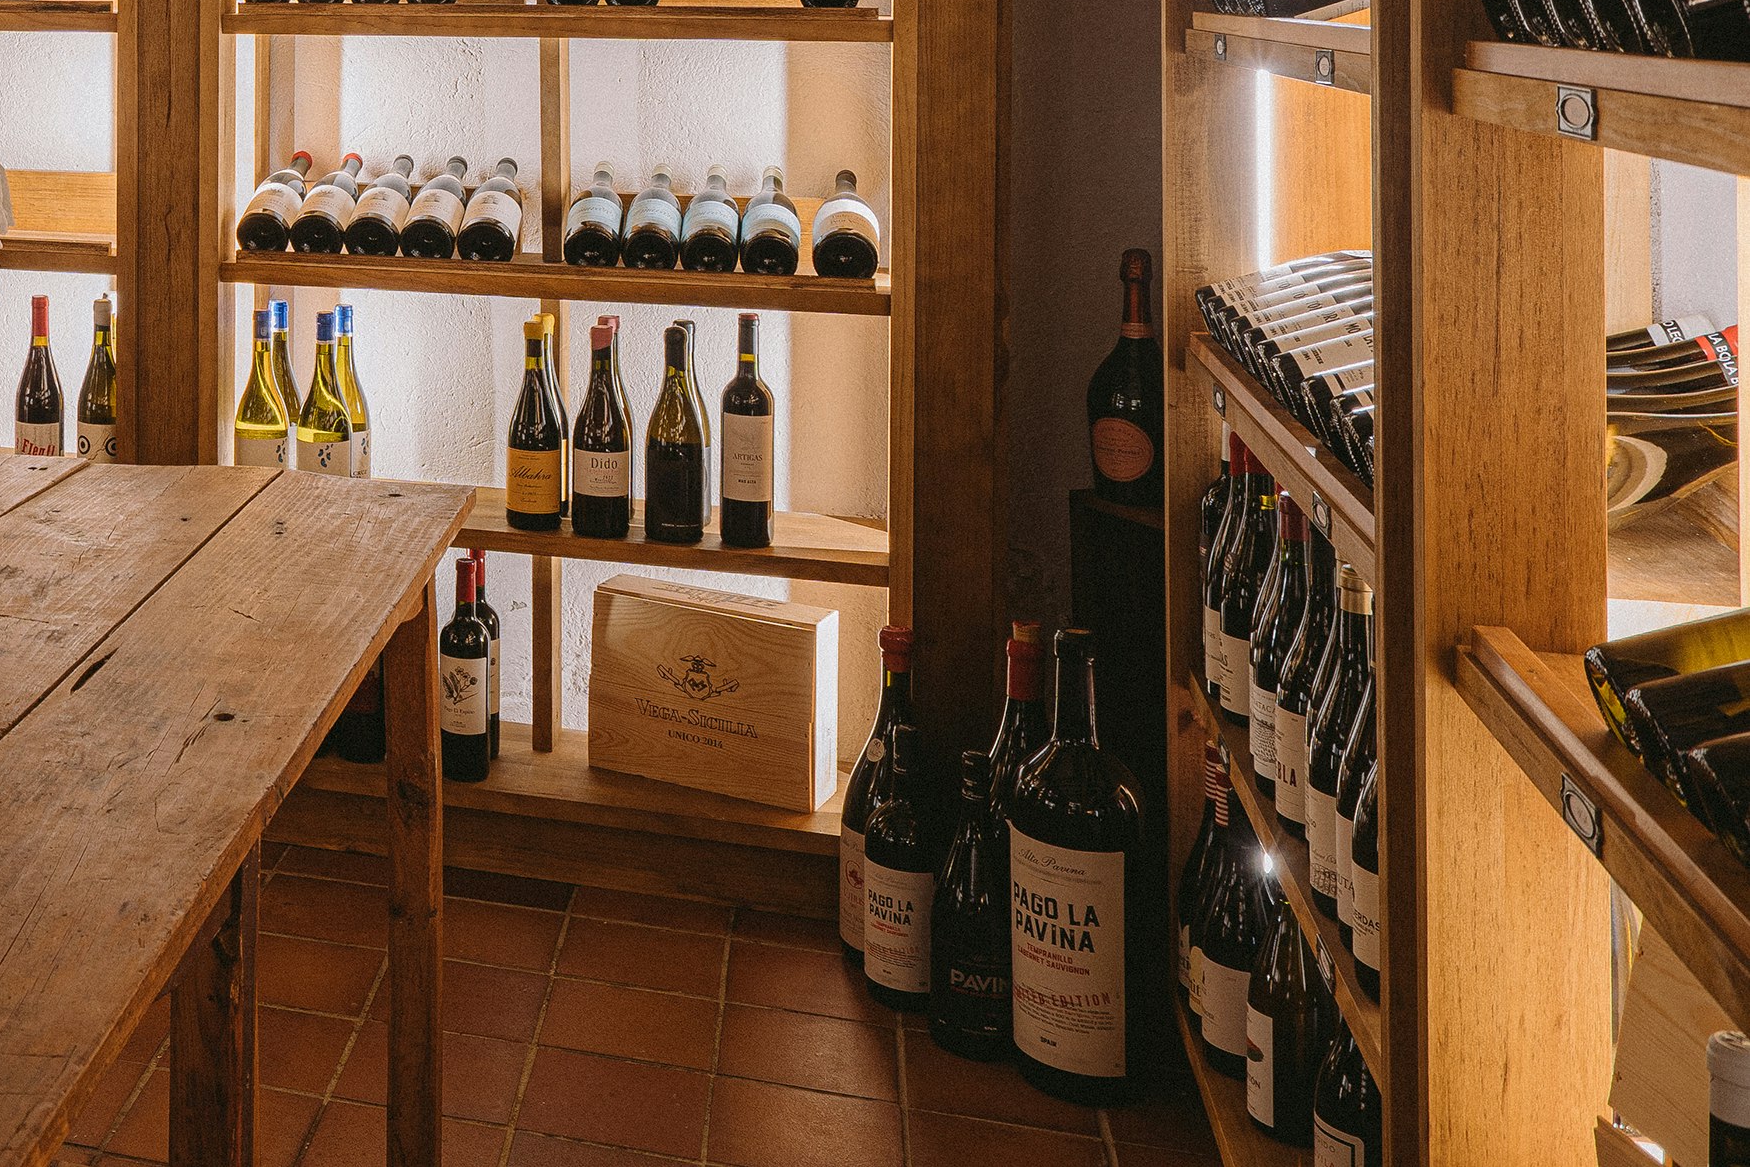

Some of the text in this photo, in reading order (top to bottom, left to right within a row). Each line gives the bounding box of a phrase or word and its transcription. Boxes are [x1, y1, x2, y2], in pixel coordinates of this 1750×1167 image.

[590, 457, 619, 470] Dido
[732, 453, 764, 462] ARTIGAS
[668, 729, 724, 749] UNICO 2014
[1275, 759, 1298, 788] BLA
[1018, 848, 1087, 876] Alta Pavina
[868, 888, 893, 910] PAGO
[897, 899, 915, 913] LA
[1013, 880, 1101, 928] PAGO LA
[1017, 944, 1091, 976] CABERNET SAUVIGNON
[1026, 942, 1073, 965] TEMPRANILLO
[1051, 992, 1112, 1008] EDITION
